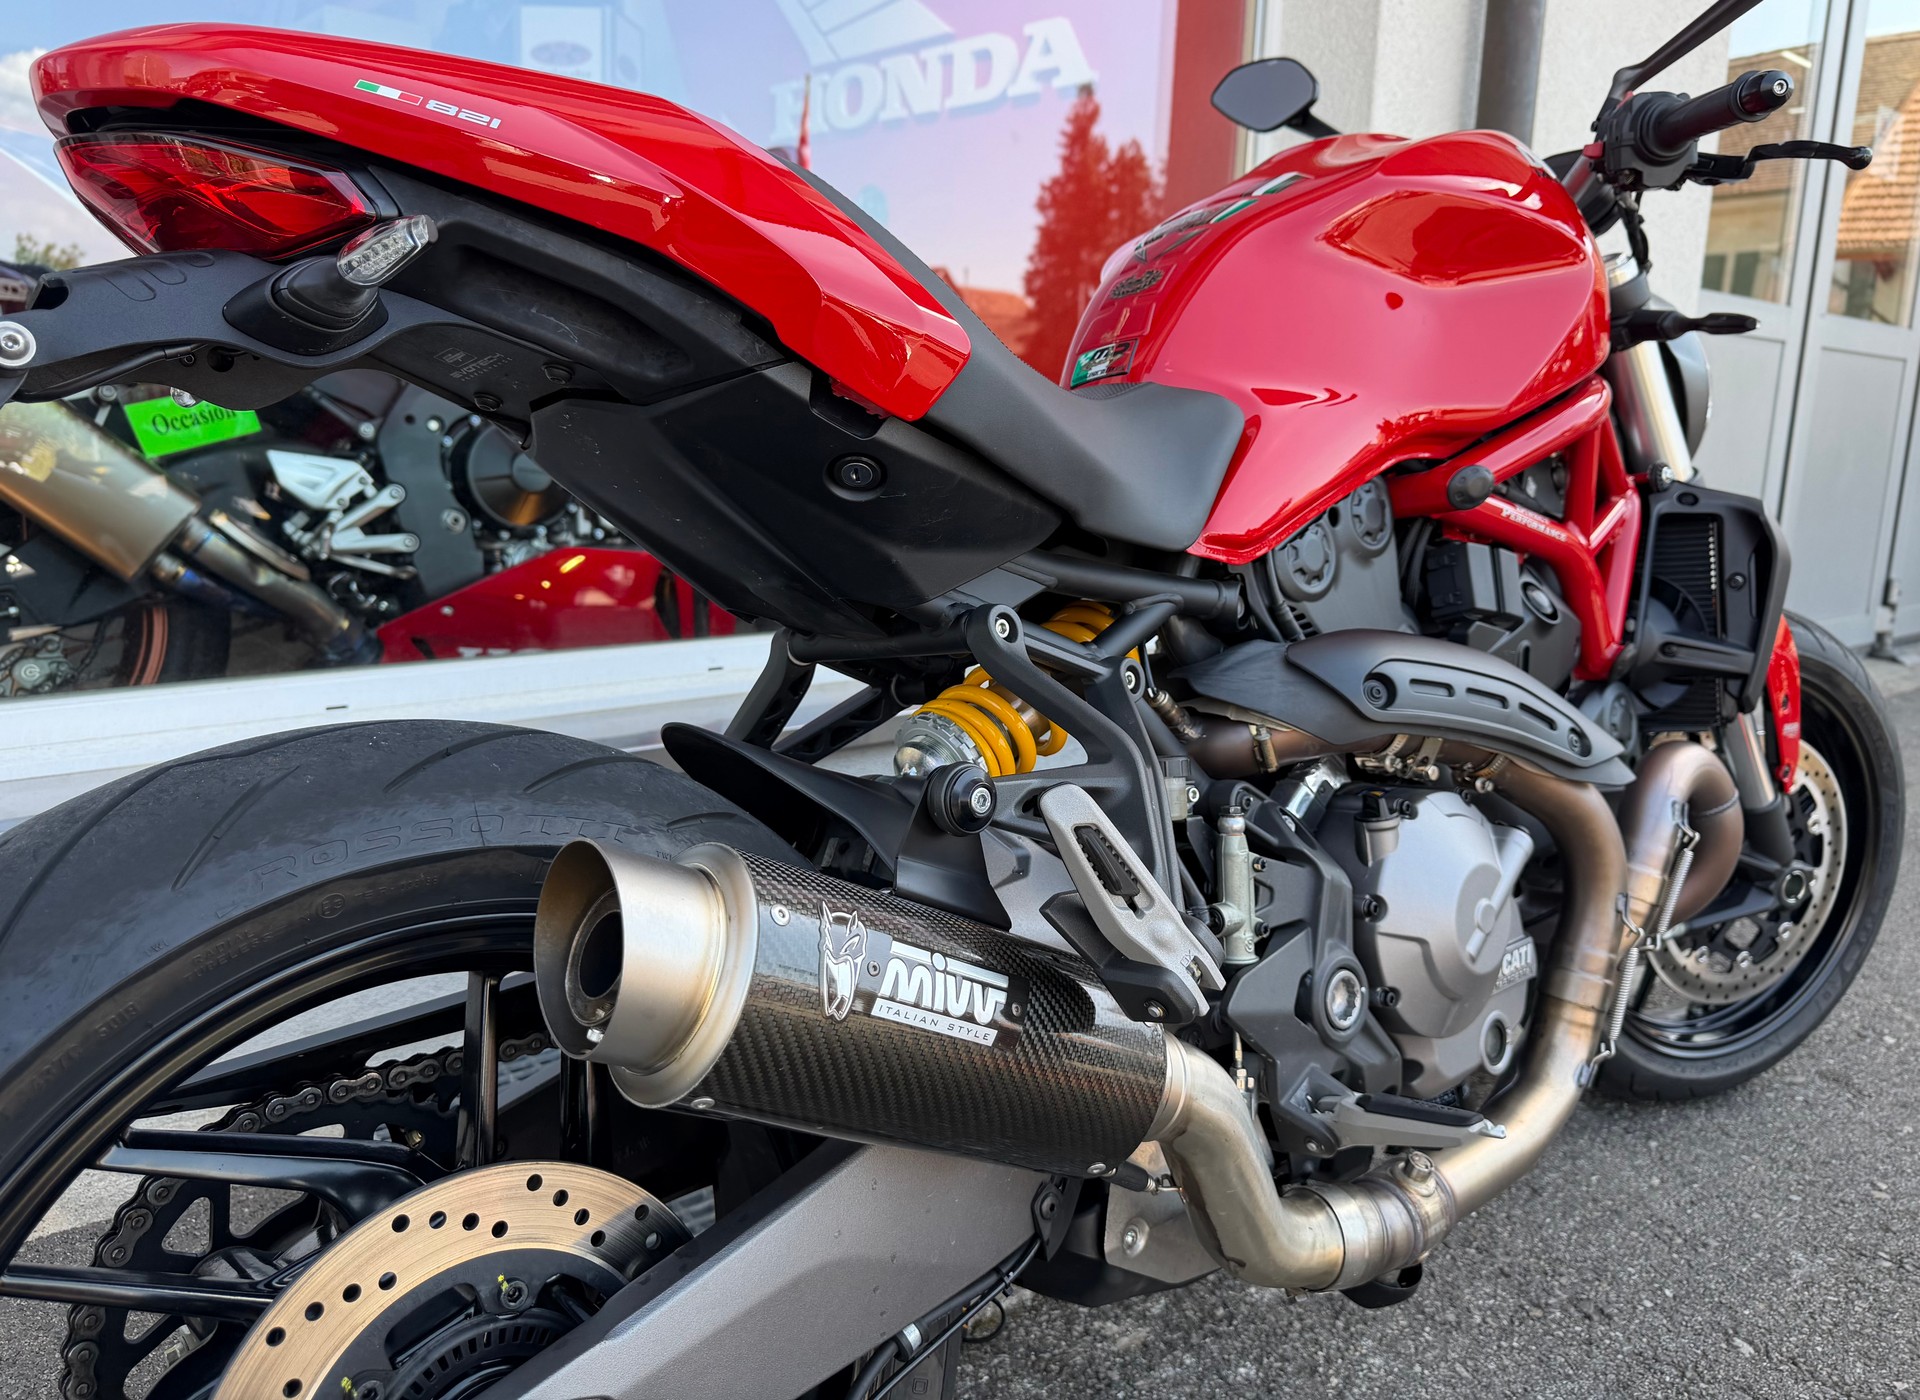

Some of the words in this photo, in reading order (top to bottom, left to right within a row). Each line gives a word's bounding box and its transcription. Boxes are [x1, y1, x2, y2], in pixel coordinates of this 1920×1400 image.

[769, 16, 1099, 141] HONDA
[425, 99, 501, 129] 821
[249, 814, 505, 892] ROSSO
[1498, 943, 1531, 976] CATI
[878, 1004, 939, 1027] ITALIAN
[947, 1023, 990, 1041] STYLE
